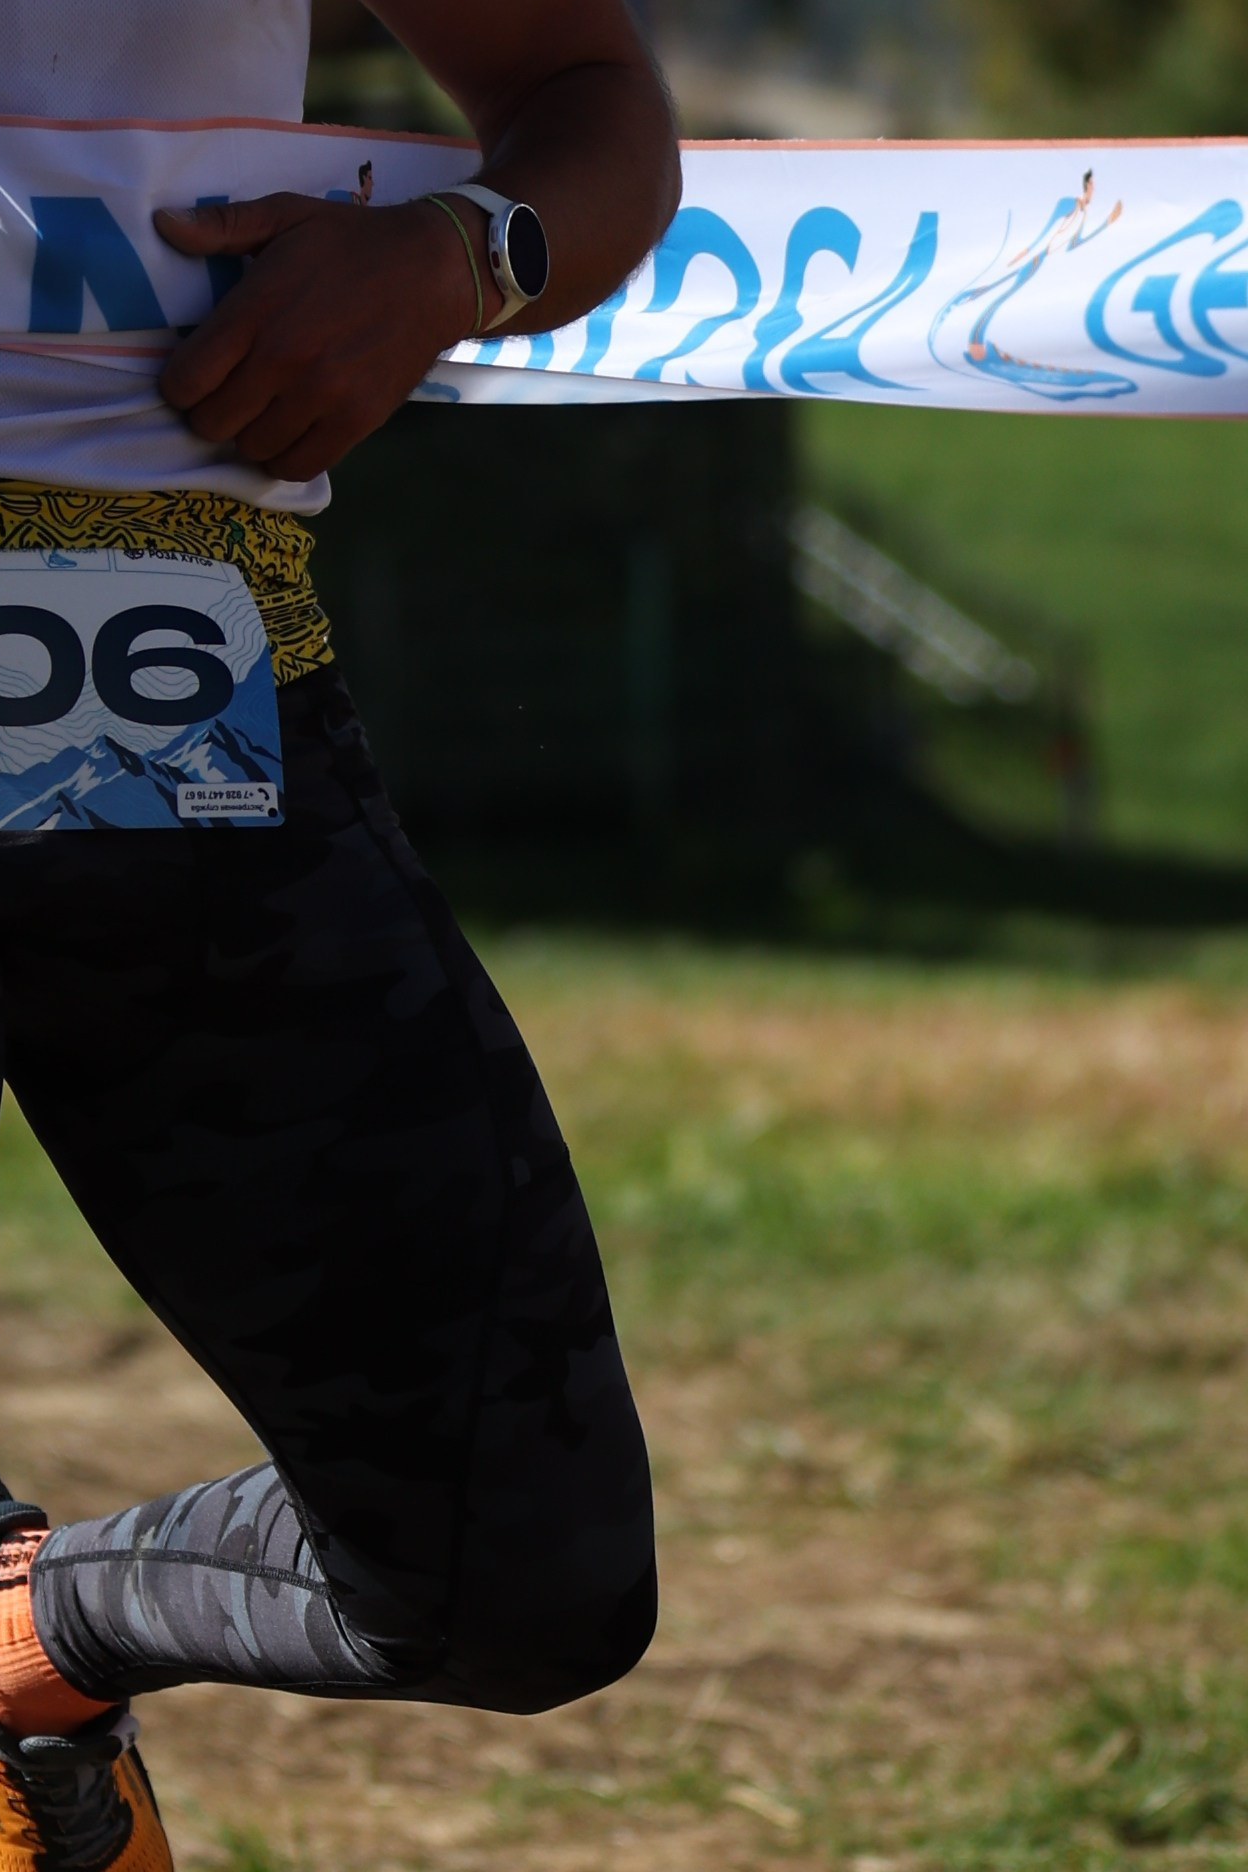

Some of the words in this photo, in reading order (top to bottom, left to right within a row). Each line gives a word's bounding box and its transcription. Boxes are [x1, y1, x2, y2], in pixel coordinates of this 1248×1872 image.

[148, 548, 178, 561] РОЗА
[179, 553, 214, 567] ХУТОР
[185, 790, 195, 800] 67
[197, 790, 206, 800] 16
[208, 790, 224, 800] 447
[243, 790, 254, 799] +7
[191, 803, 219, 812] служба
[220, 803, 265, 812] Экстренная
